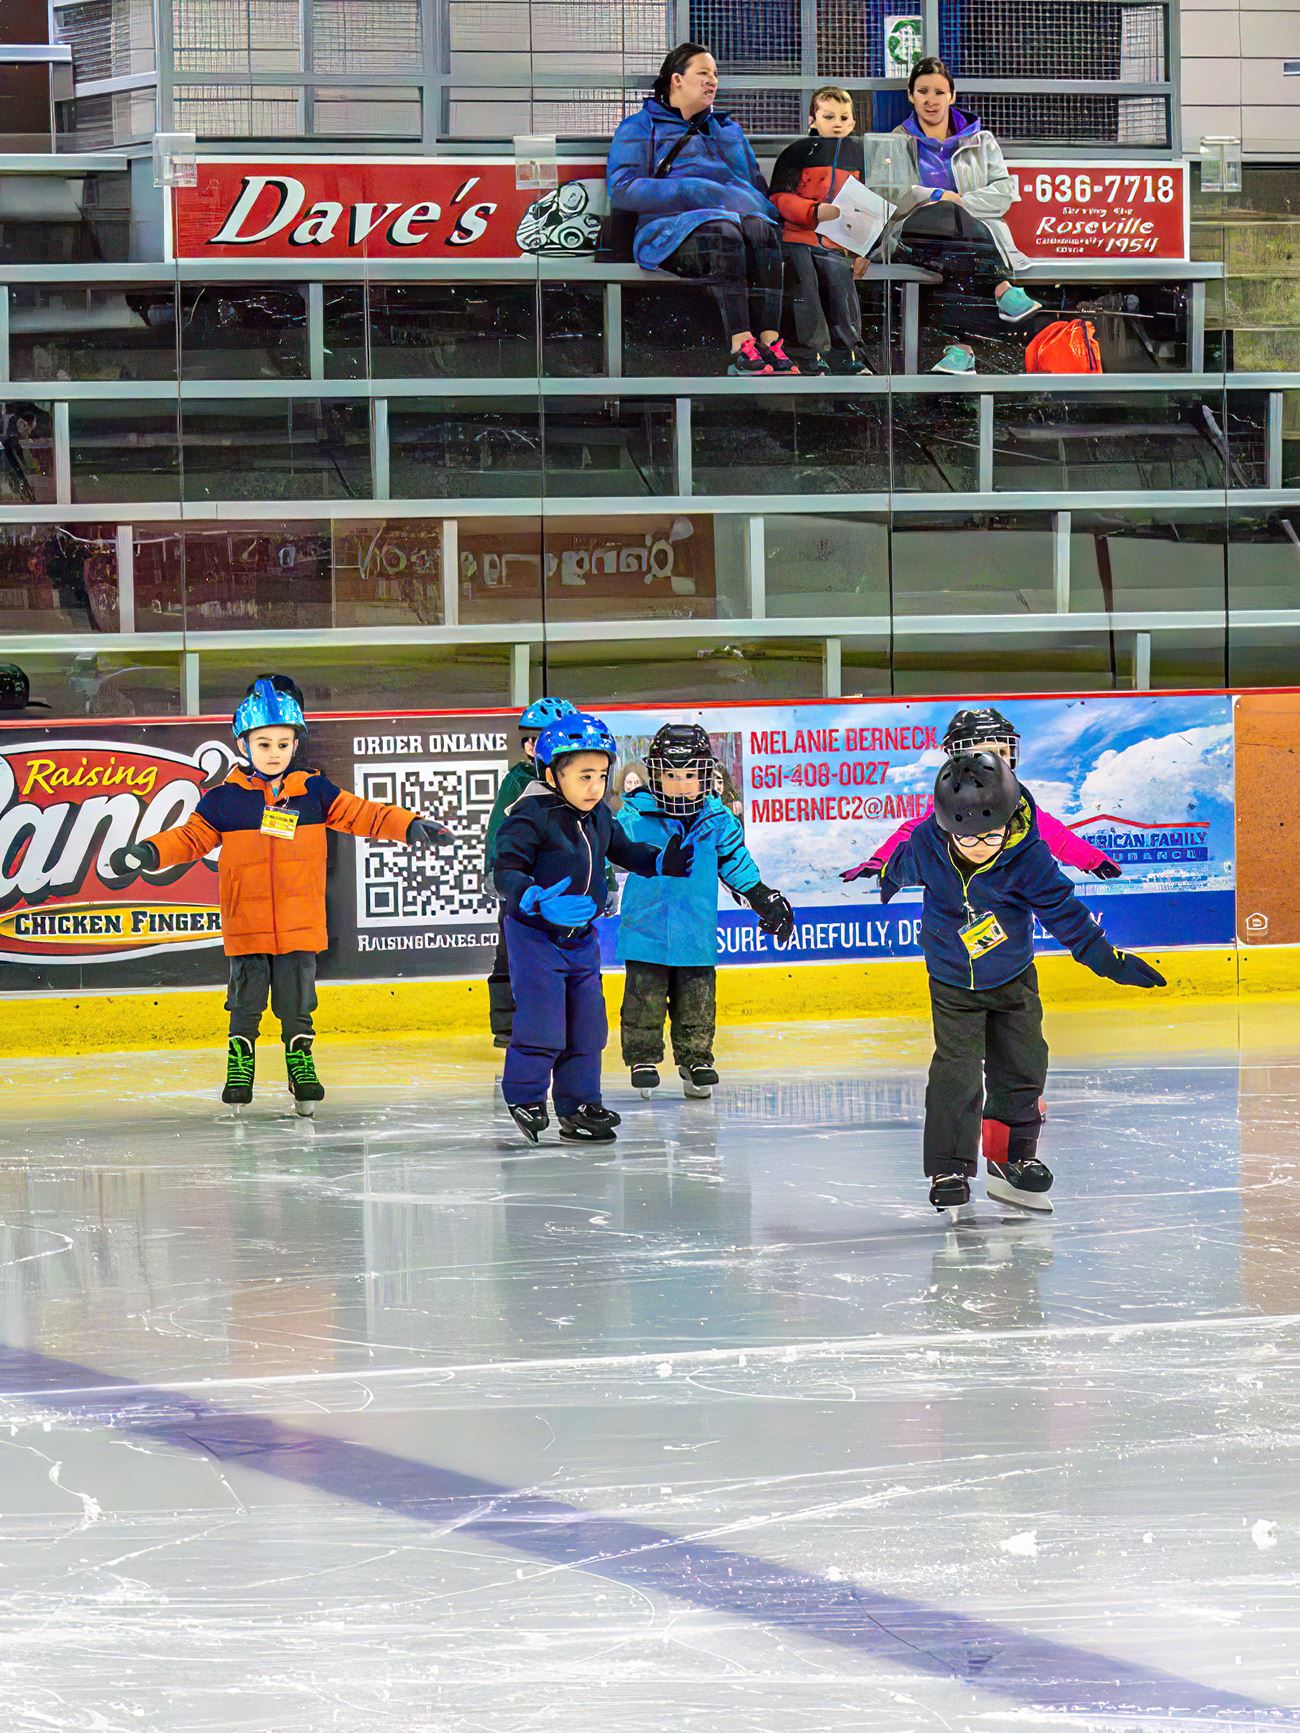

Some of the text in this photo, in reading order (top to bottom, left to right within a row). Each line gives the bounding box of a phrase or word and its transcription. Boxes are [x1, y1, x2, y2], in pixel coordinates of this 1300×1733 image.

[204, 176, 497, 246] Dave's
[1036, 216, 1154, 235] Roseville
[1105, 237, 1159, 253] 1954
[353, 733, 507, 755] ORDER ONLINE
[751, 726, 939, 755] MELANIE BERNECK
[22, 757, 158, 796] Raising
[751, 761, 889, 789] 651-408-0027
[1082, 831, 1208, 849] ERICAN FAMILY
[15, 910, 221, 936] CHICKEN FINGER
